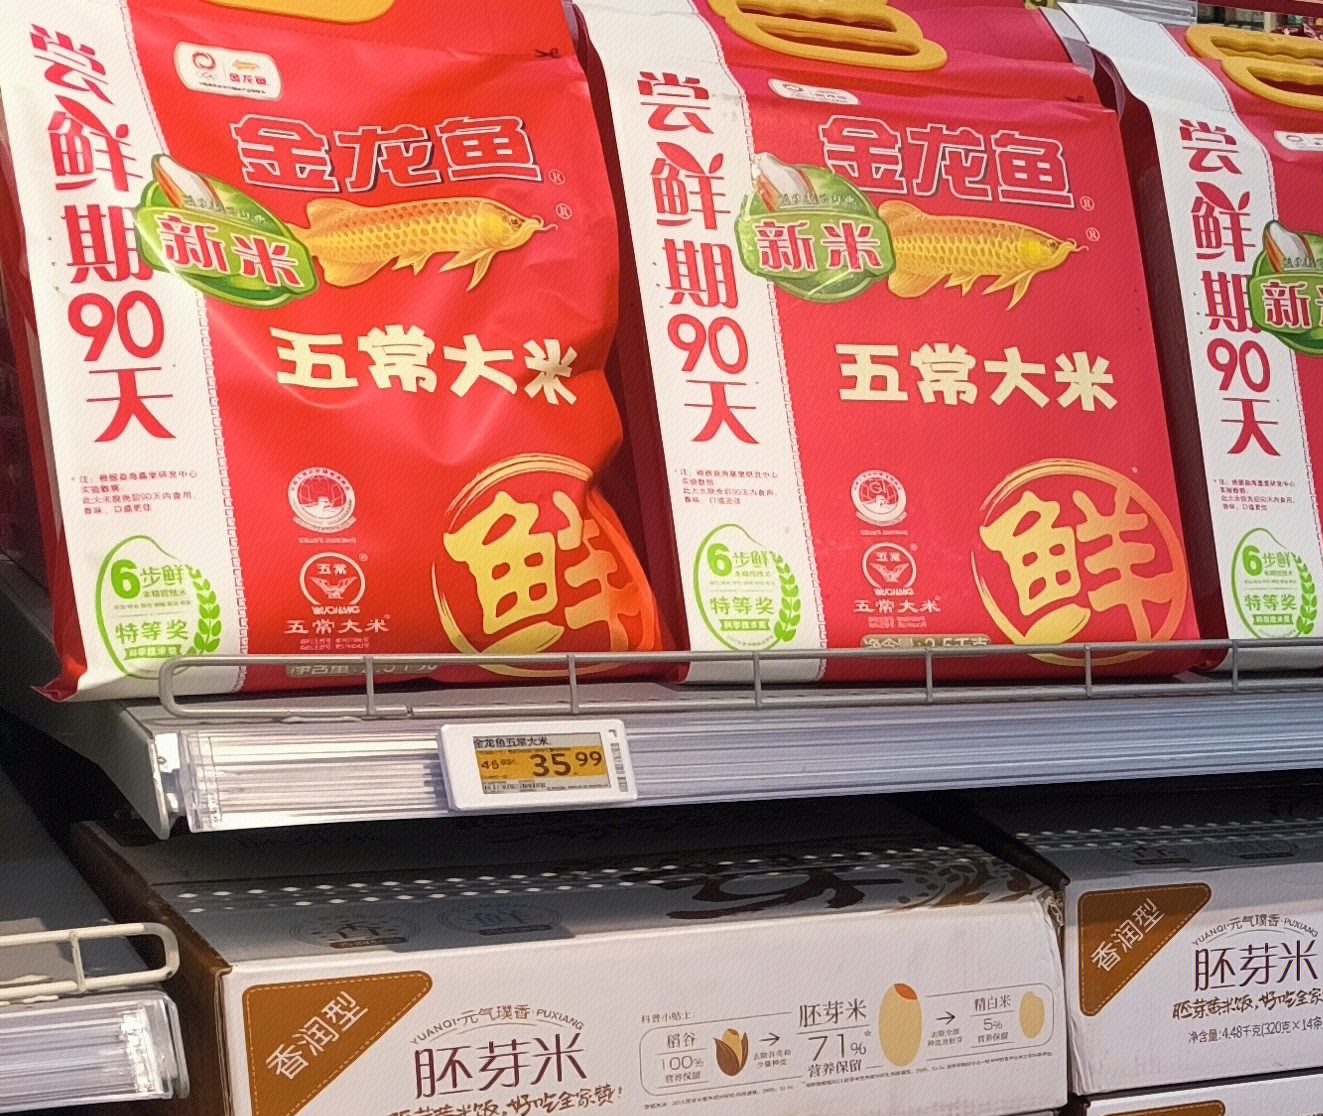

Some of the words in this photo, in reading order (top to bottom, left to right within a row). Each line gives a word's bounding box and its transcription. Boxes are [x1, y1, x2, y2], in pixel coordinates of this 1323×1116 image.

[231, 113, 542, 194] 金龙鱼
[818, 114, 1075, 210] 金龙鱼
[30, 23, 176, 444] 尝鲜期90天
[156, 212, 302, 289] 新米
[637, 70, 760, 444] 尝鲜期90天
[756, 219, 882, 273] 新米
[1179, 120, 1281, 457] 尝鲜期90天
[270, 323, 578, 407] 五常大米
[834, 342, 1117, 411] 五常大米
[110, 559, 185, 599] 6步鲜
[443, 489, 645, 640] 鲜
[707, 542, 769, 577] 6步鲜
[979, 489, 1172, 637] 鲜
[1243, 546, 1293, 577] 6步鲜
[115, 620, 189, 644] 特等奖
[284, 619, 389, 634] 五常大米
[708, 593, 774, 616] 特等奖
[1244, 593, 1297, 612] 特等奖
[1091, 898, 1166, 973] 香润型
[1194, 940, 1318, 992] 胚芽米
[266, 991, 368, 1080] 香润型
[799, 998, 867, 1028] 胚芽米
[415, 1032, 587, 1100] 胚芽米
[660, 1056, 704, 1071] 100%
